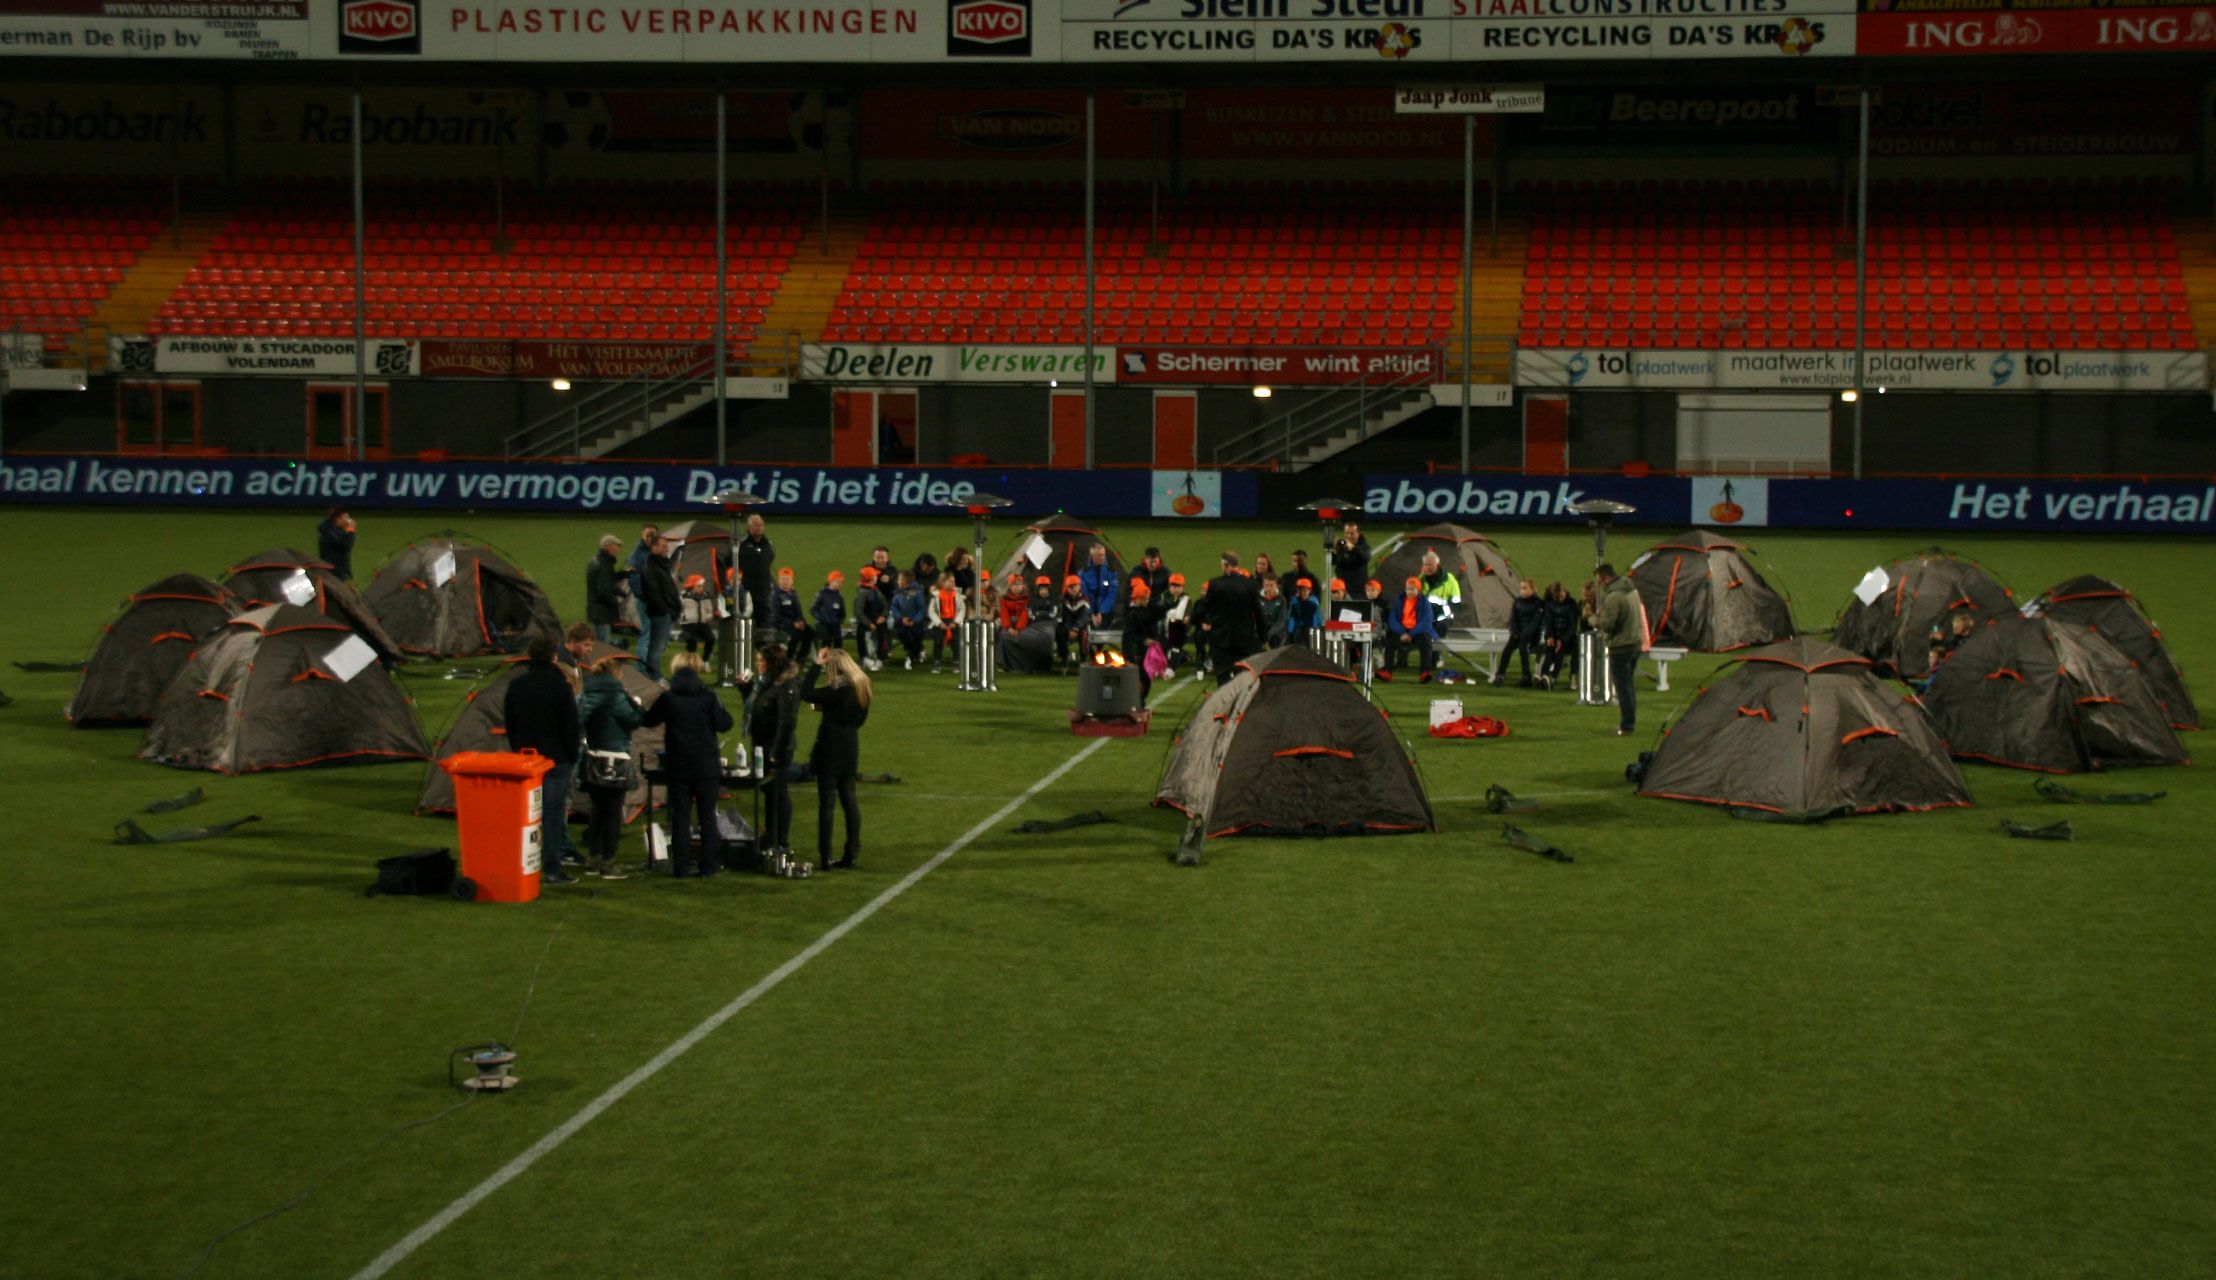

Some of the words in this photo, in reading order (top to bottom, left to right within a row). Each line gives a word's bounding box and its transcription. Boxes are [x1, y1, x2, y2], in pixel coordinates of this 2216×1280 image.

[104, 2, 300, 18] WWW.VANDERSTRUIJK.NL
[350, 9, 408, 29] KIVO
[960, 11, 1020, 31] KIVO
[452, 9, 606, 33] PLASTIC
[621, 10, 917, 34] VERPAKKINGEN
[2096, 16, 2180, 45] ING
[84, 28, 114, 47] De
[122, 29, 166, 51] Rijp
[174, 30, 202, 47] bv
[224, 30, 261, 39] RAMEN
[239, 40, 280, 49] DEUREN
[1093, 30, 1255, 50] RECYCLING
[1272, 29, 1334, 49] DA'S
[1484, 25, 1651, 47] RECYCLING
[1669, 24, 1733, 46] DA'S
[1904, 22, 1984, 48] ING
[252, 50, 299, 60] TRAPPEN
[1497, 93, 1543, 109] tribune
[1609, 93, 1800, 127] Beerepoot
[0, 100, 208, 143] Rabobank
[301, 103, 519, 145] Rabobank
[951, 116, 1002, 135] VAN
[2013, 135, 2178, 154] STEIGERBOUW
[169, 342, 237, 354] AFBOUW
[243, 342, 255, 354] &
[260, 343, 356, 355] STUCADOOR
[548, 344, 579, 358] HET
[227, 357, 315, 369] VOLENDAM
[560, 361, 590, 375] VAN
[825, 348, 932, 377] Deelen
[957, 347, 1105, 373] Verswaren
[1157, 353, 1287, 372] Schermer
[1304, 355, 1360, 372] wint
[1367, 355, 1431, 374] altijd
[1598, 352, 1632, 373] tol
[1636, 361, 1714, 385] plaatwerk
[1731, 352, 1835, 371] maatwerk
[1869, 352, 1975, 374] plaatwerk
[2025, 354, 2061, 377] tol
[2064, 363, 2150, 380] plaatwerk
[86, 461, 231, 494] kennen
[246, 464, 375, 496] achter
[386, 473, 445, 498] uw
[457, 474, 666, 509] vermogen.
[685, 472, 755, 503] Dat
[766, 474, 801, 503] is
[811, 475, 879, 506] het
[1364, 480, 1584, 515] abobank
[1948, 485, 2031, 520] Het
[2043, 486, 2216, 522] verhaal
